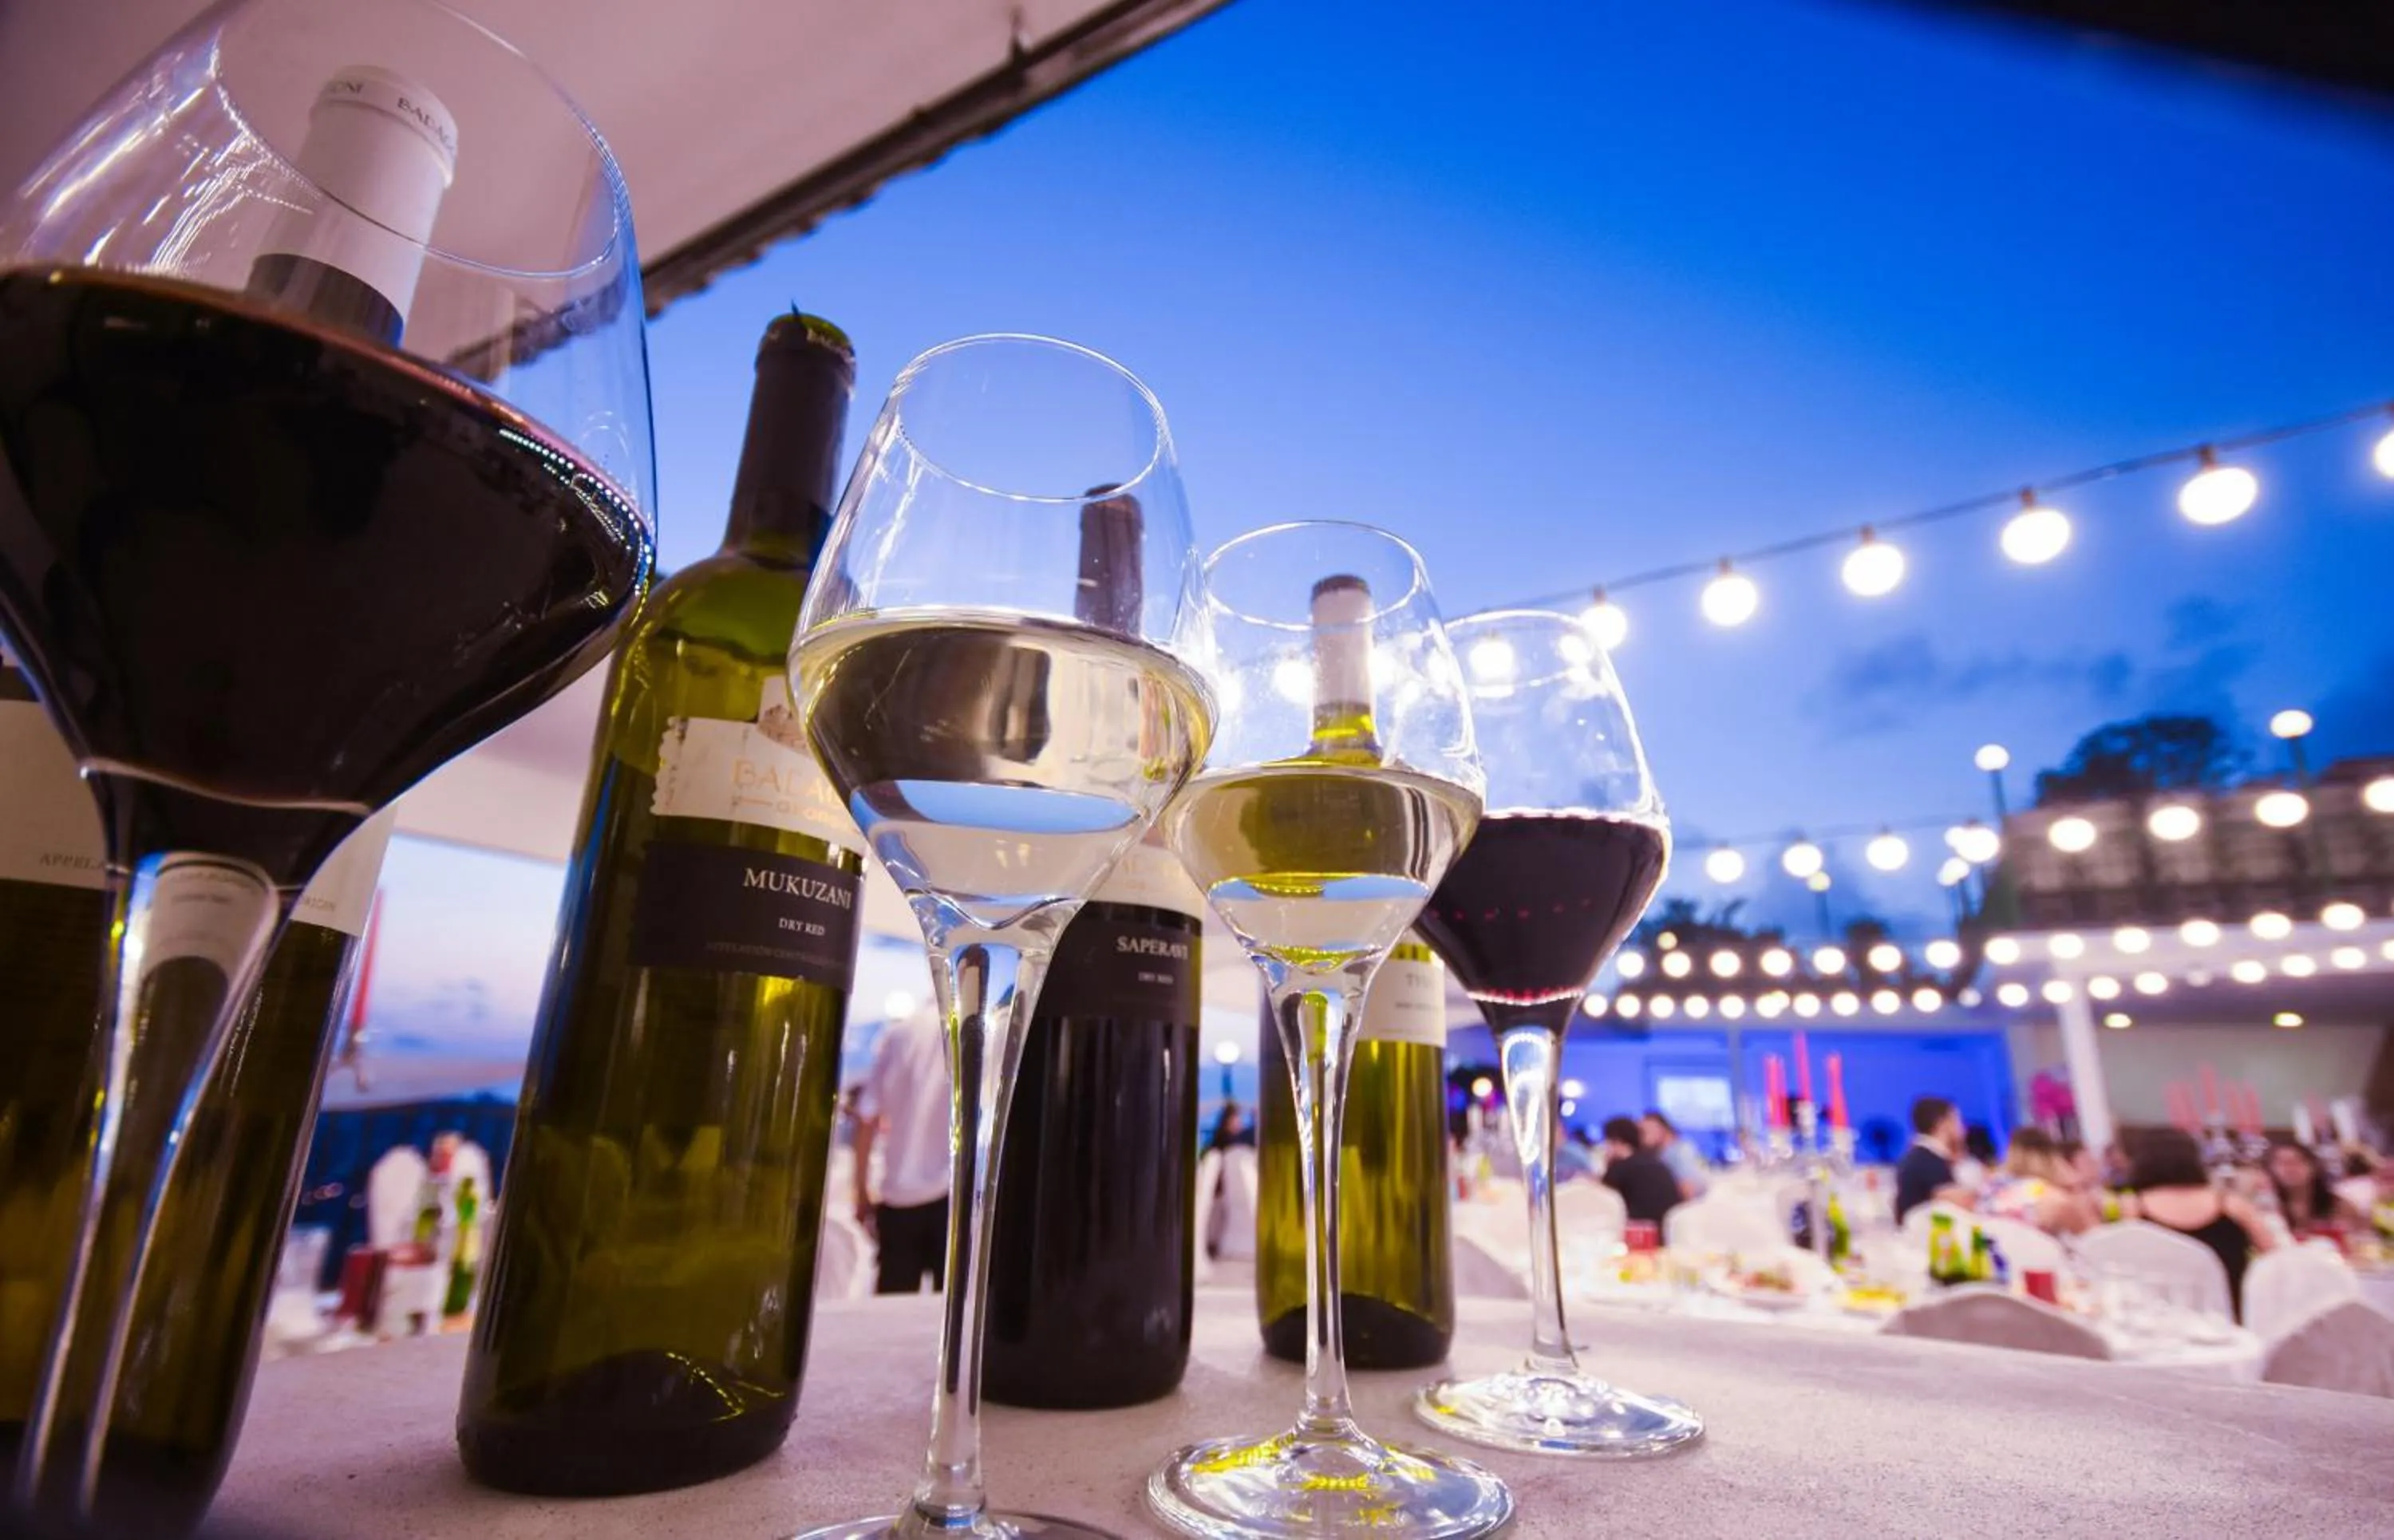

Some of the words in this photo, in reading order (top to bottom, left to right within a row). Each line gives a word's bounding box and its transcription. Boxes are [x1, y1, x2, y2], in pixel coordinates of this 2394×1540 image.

[742, 867, 851, 909] MUKUZANI
[778, 918, 804, 932] DRY
[804, 922, 826, 936] RED
